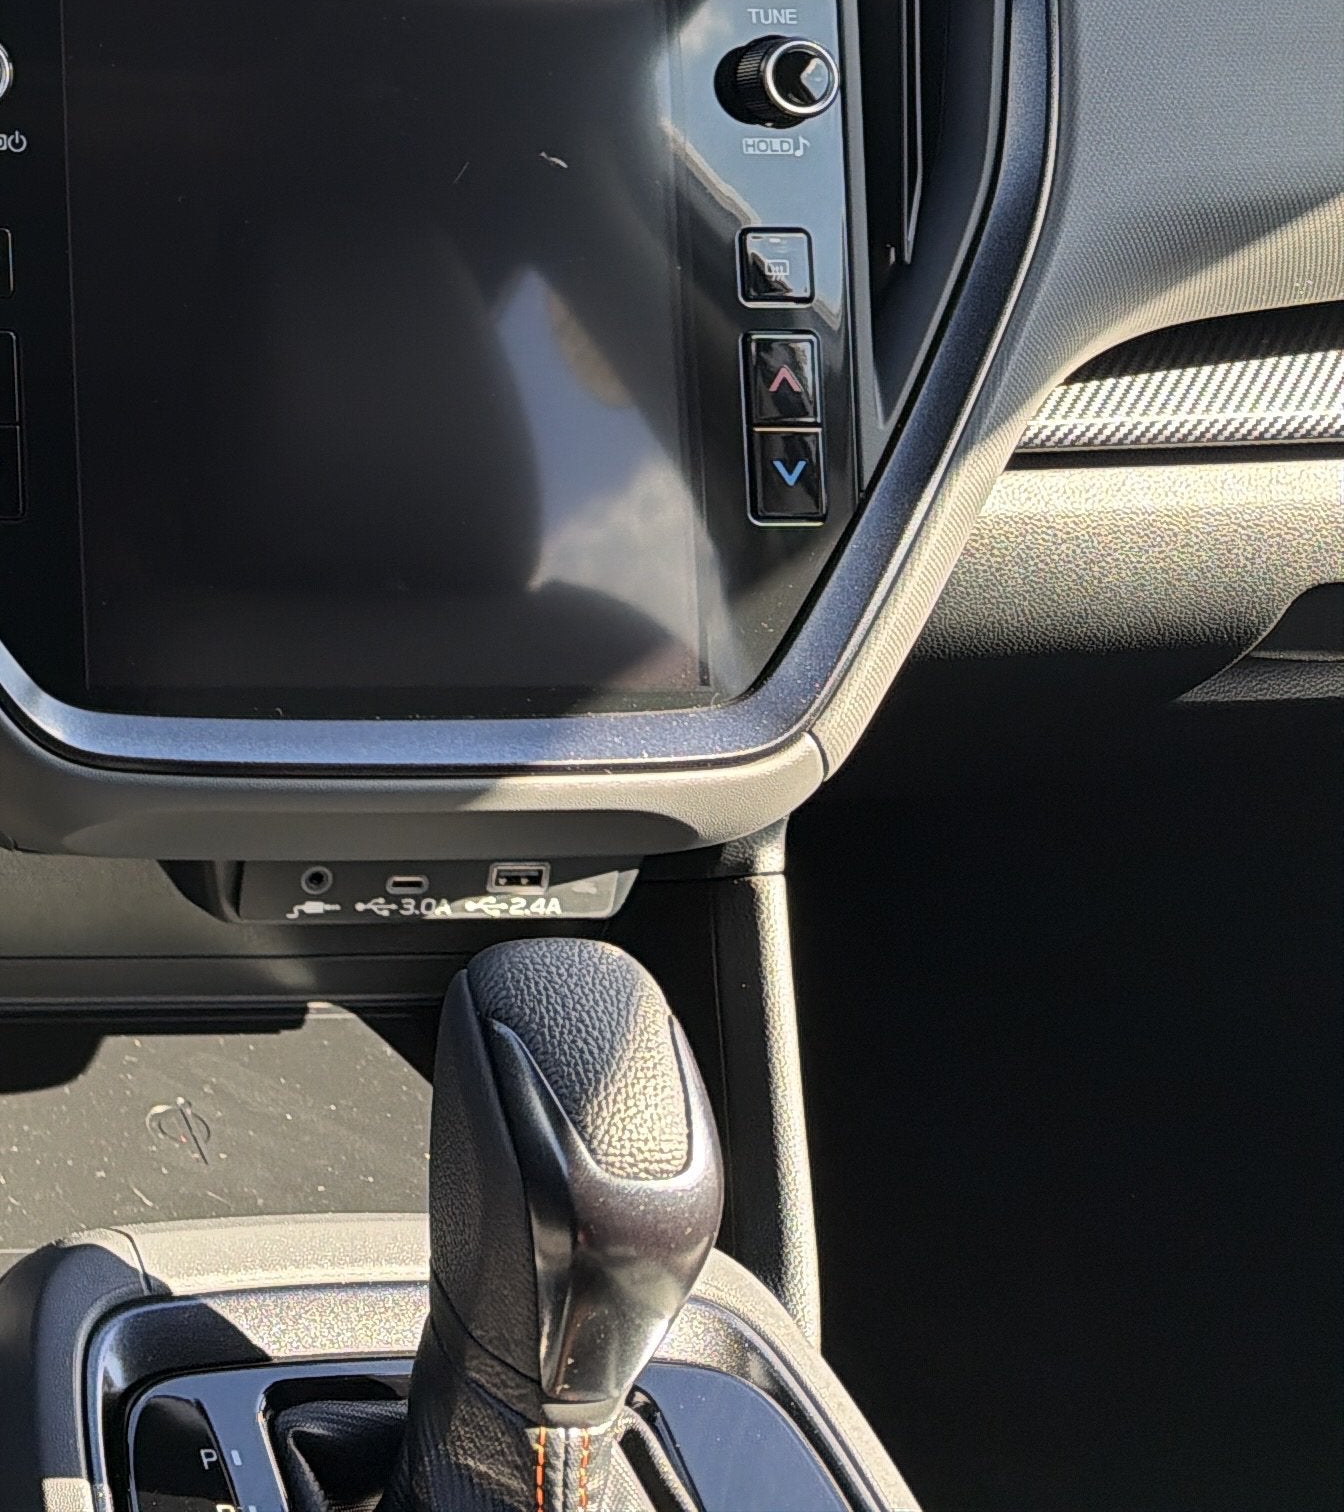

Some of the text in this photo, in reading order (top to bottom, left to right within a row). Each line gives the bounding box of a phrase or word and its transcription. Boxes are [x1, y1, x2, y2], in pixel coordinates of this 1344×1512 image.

[747, 8, 798, 25] TUNE
[744, 138, 793, 154] HOLD
[399, 898, 452, 916] 3.0A
[507, 898, 562, 916] 2.4A
[199, 1448, 218, 1470] P
